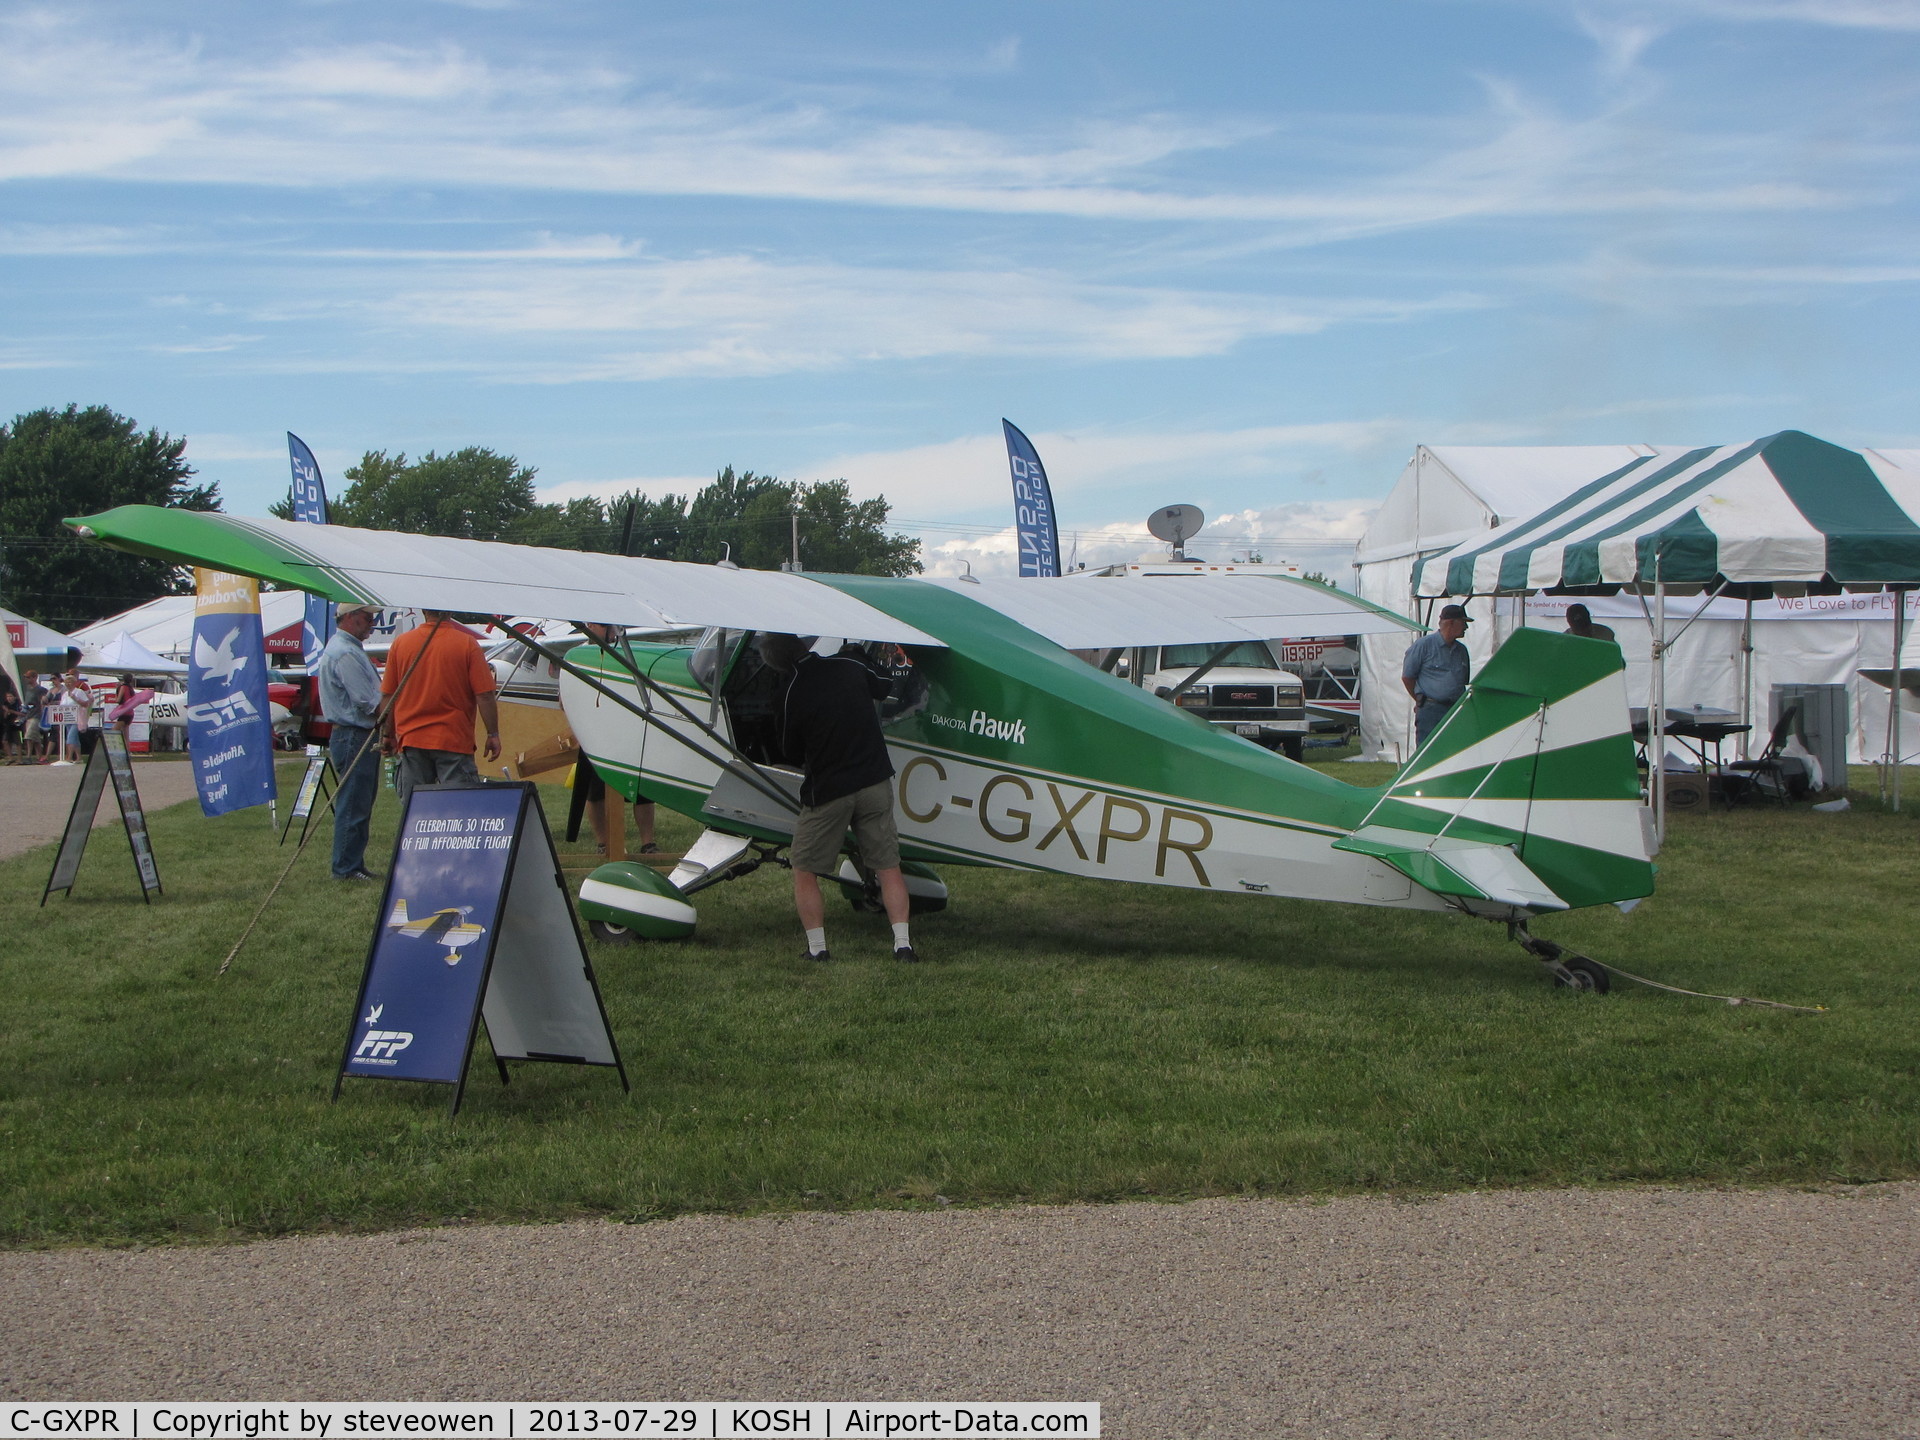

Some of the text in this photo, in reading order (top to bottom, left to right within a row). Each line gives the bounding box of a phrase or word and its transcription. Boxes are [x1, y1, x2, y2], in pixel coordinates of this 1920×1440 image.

[1778, 597, 1804, 610] We
[1809, 597, 1846, 610] Love
[1851, 598, 1866, 610] to
[268, 637, 299, 649] maf.org
[1231, 692, 1257, 700] GMC
[53, 712, 63, 723] NO
[931, 708, 1027, 745] DAKOTA Hawk
[415, 817, 505, 832] CELEBRATING 30 YEARS
[898, 755, 1214, 888] C-GXPR
[402, 837, 413, 850] OF
[431, 835, 482, 850] AFFORDABLE
[484, 834, 513, 850] FLIGHT
[355, 1030, 414, 1057] FFP
